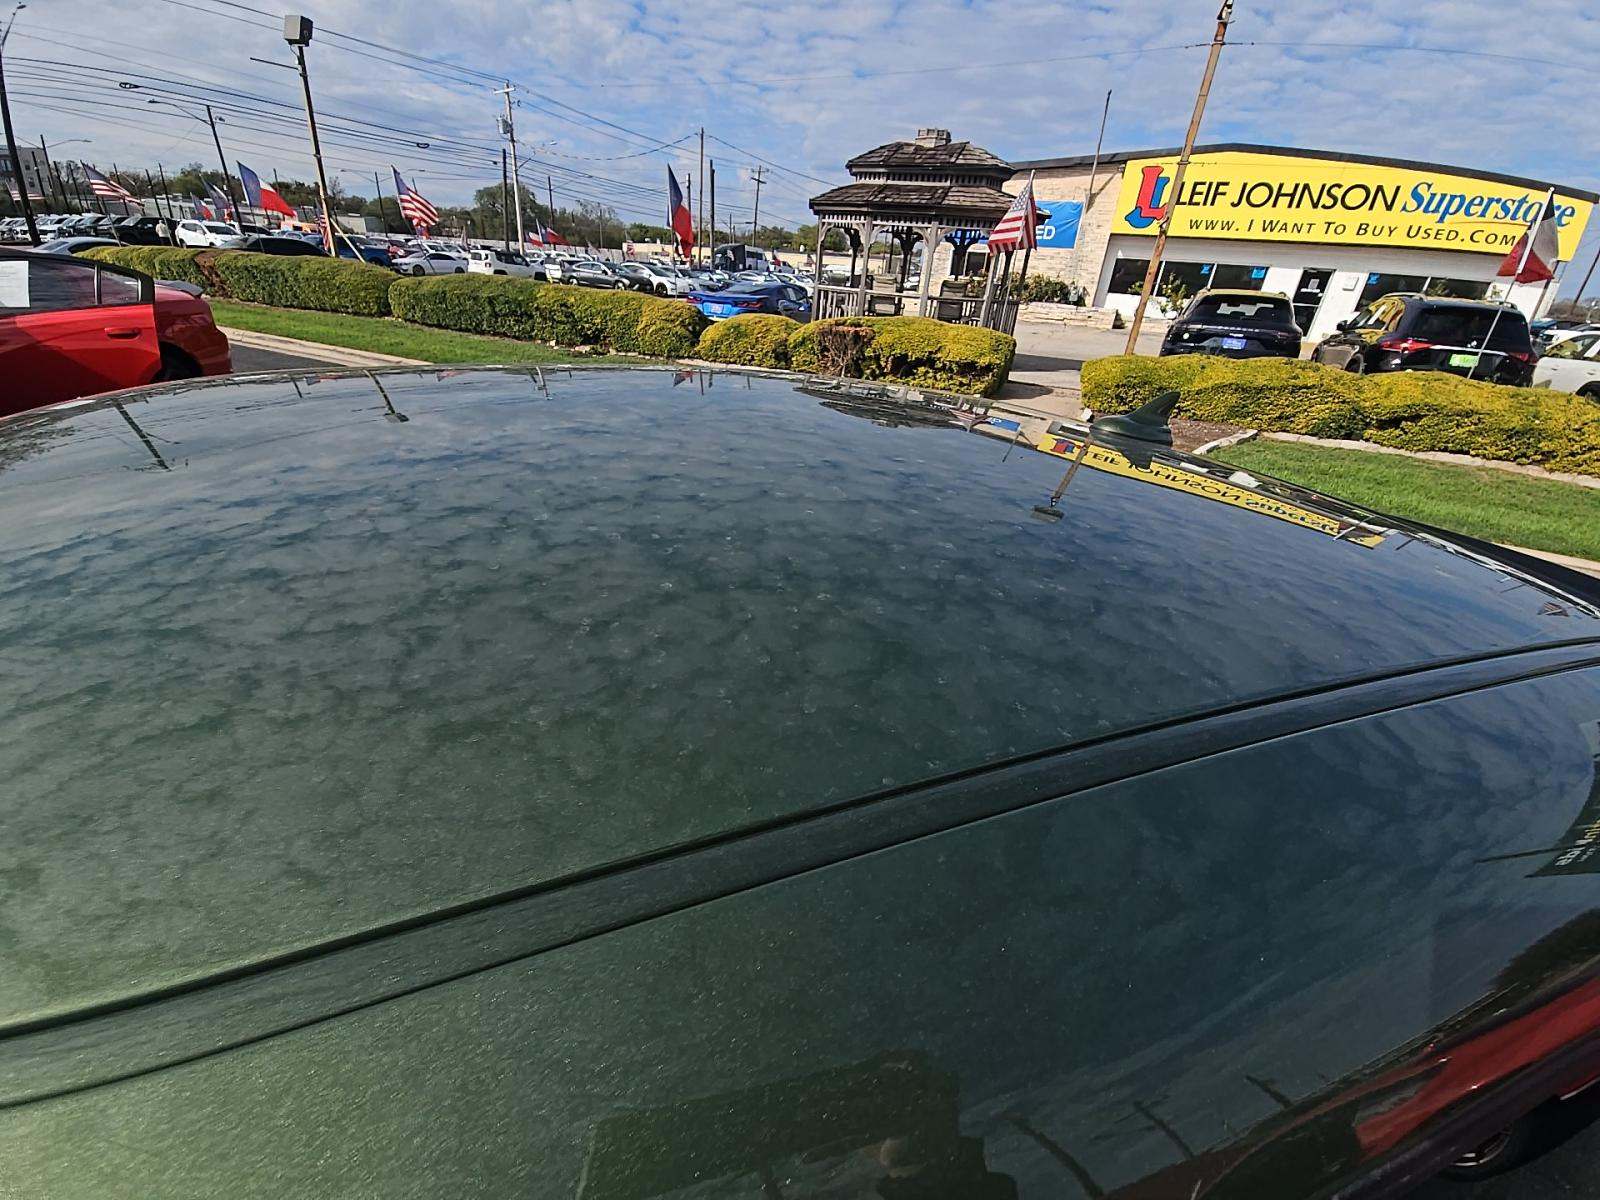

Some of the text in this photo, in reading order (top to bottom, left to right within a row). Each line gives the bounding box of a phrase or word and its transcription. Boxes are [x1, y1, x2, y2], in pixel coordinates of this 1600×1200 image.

[1175, 181, 1230, 206] LEIF
[1230, 181, 1401, 212] JOHNSON
[1247, 218, 1255, 232] I
